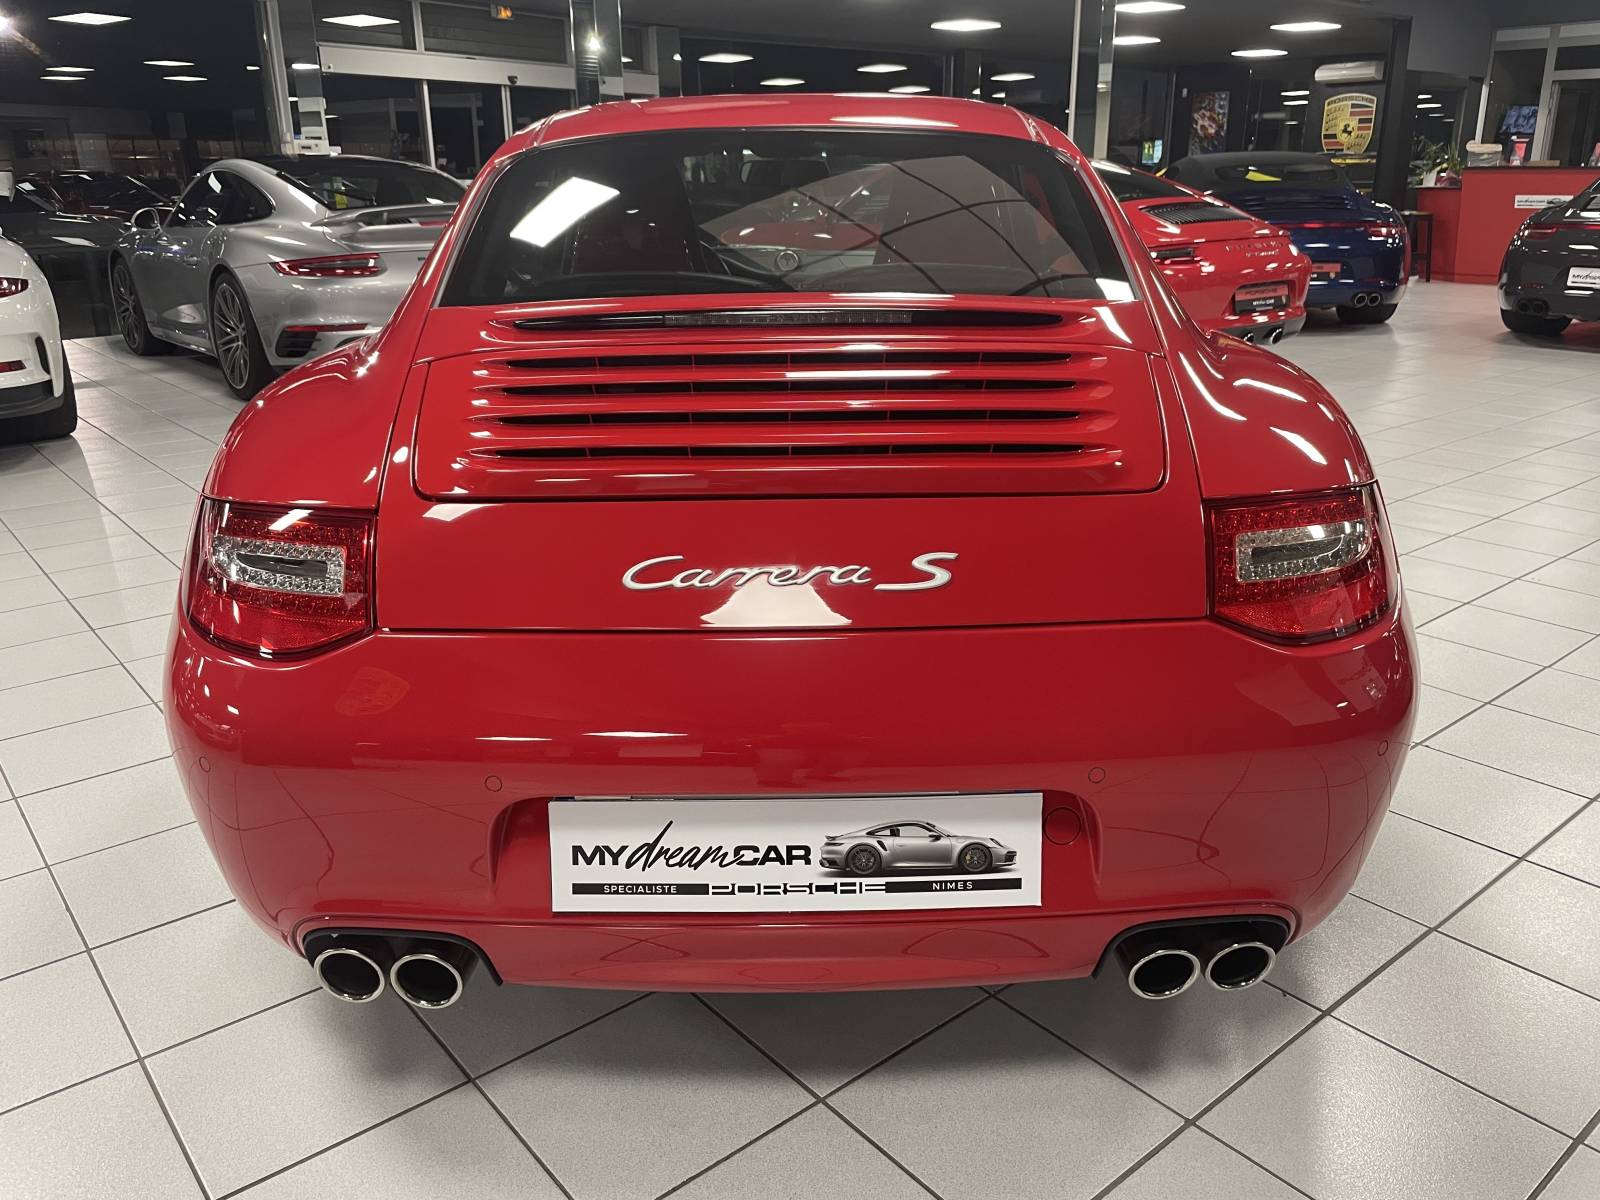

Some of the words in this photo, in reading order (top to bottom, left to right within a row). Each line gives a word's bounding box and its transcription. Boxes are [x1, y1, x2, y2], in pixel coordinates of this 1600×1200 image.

[622, 555, 872, 590] Carrera
[873, 552, 958, 591] S
[603, 885, 678, 894] SPECIALISTE
[708, 881, 887, 896] PORSCHE
[932, 881, 974, 891] NIMES
